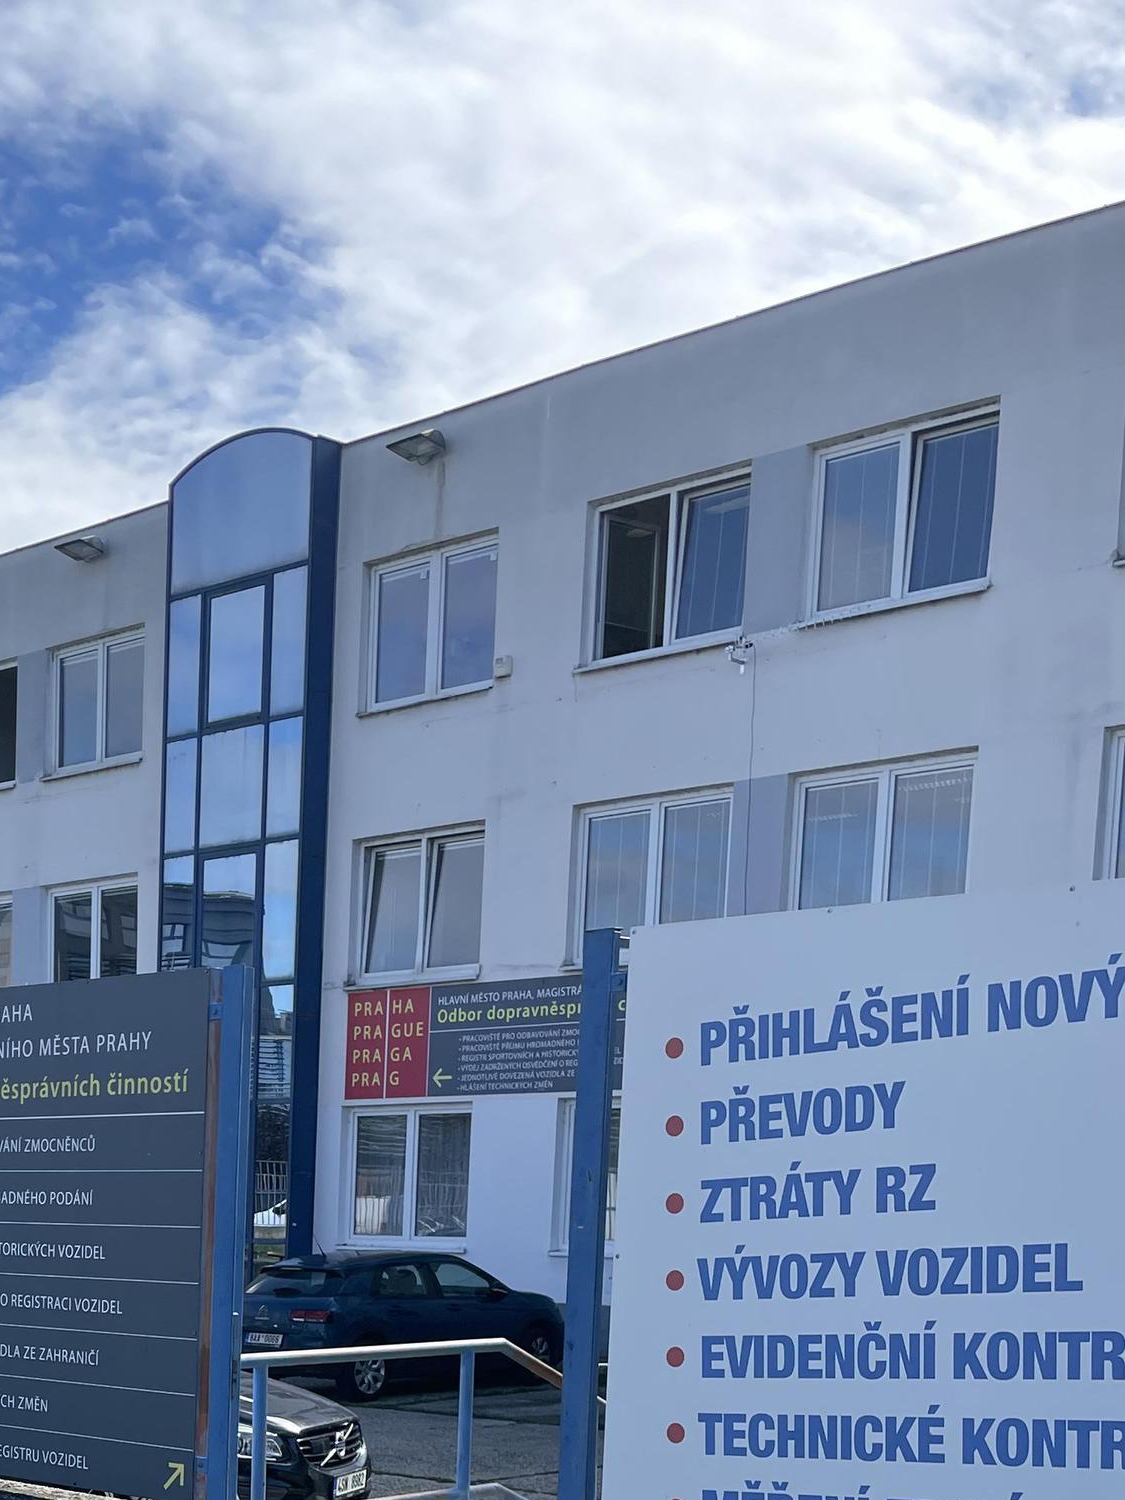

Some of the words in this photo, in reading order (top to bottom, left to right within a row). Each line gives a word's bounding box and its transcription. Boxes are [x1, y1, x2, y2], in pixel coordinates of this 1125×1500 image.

[354, 1001, 383, 1017] PRA
[392, 999, 414, 1014] HA
[438, 996, 469, 1007] HLAVNÍ
[472, 992, 500, 1004] MĚSTO
[438, 1006, 482, 1023] Odbor
[700, 974, 970, 1066] PŘIHLÁŠENÍ
[353, 1024, 382, 1041] PRA
[391, 1021, 424, 1038] GUE
[502, 1032, 515, 1041] PRO
[39, 1034, 90, 1057] MĚSTA
[96, 1030, 152, 1053] PRAHY
[352, 1048, 381, 1064] PRA
[390, 1047, 412, 1062] GA
[106, 1067, 189, 1096] činností
[351, 1072, 380, 1087] PRA
[390, 1072, 399, 1086] G
[700, 1081, 906, 1145] PŘEVODY
[24, 1134, 96, 1153] ZMOCNĚNCŮ
[49, 1189, 93, 1206] PODÁNÍ
[700, 1160, 861, 1223] ZTRÁTY
[876, 1163, 936, 1214] RZ
[58, 1245, 106, 1260] VOZIDEL
[697, 1245, 866, 1300] VÝVOZY
[876, 1243, 1083, 1297] VOZIDEL
[0, 1293, 8, 1306] O
[11, 1293, 72, 1311] REGISTRACI
[74, 1298, 123, 1315] VOZIDEL
[23, 1345, 36, 1360] ZE
[38, 1347, 100, 1366] ZAHRANIČÍ
[701, 1321, 937, 1380] EVIDENČNÍ
[17, 1395, 48, 1413] ZMĚN
[698, 1405, 945, 1464] TECHNICKÉ
[42, 1450, 89, 1470] VOZIDEL
